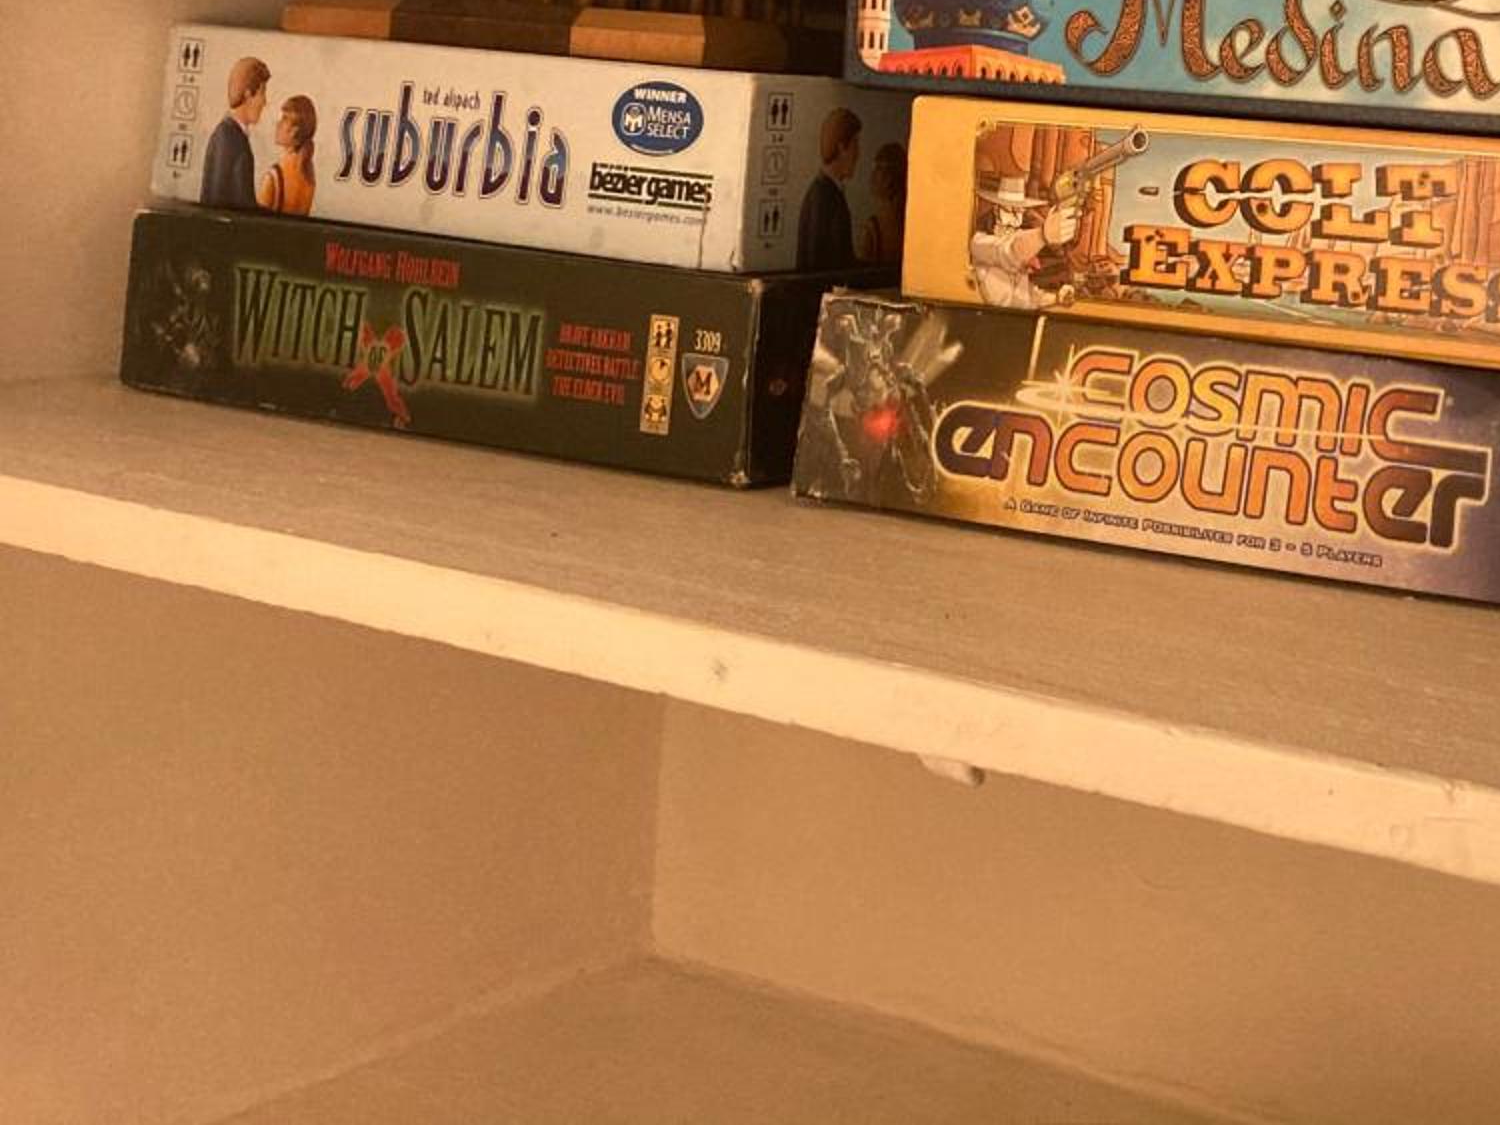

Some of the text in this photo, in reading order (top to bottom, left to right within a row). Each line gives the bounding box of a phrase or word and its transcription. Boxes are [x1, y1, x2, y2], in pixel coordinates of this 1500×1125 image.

[422, 86, 481, 112] ted alspach
[633, 88, 688, 104] WINNER
[336, 80, 571, 209] suburbia
[647, 123, 690, 140] SELECT
[1172, 158, 1458, 248] COLT
[235, 264, 368, 370] WITCH
[403, 287, 545, 398] SALEM
[694, 329, 722, 354] 3309
[1005, 497, 1017, 513] A
[1020, 500, 1059, 517] GAME
[1061, 506, 1081, 520] OF
[1082, 509, 1139, 529] INFINITE
